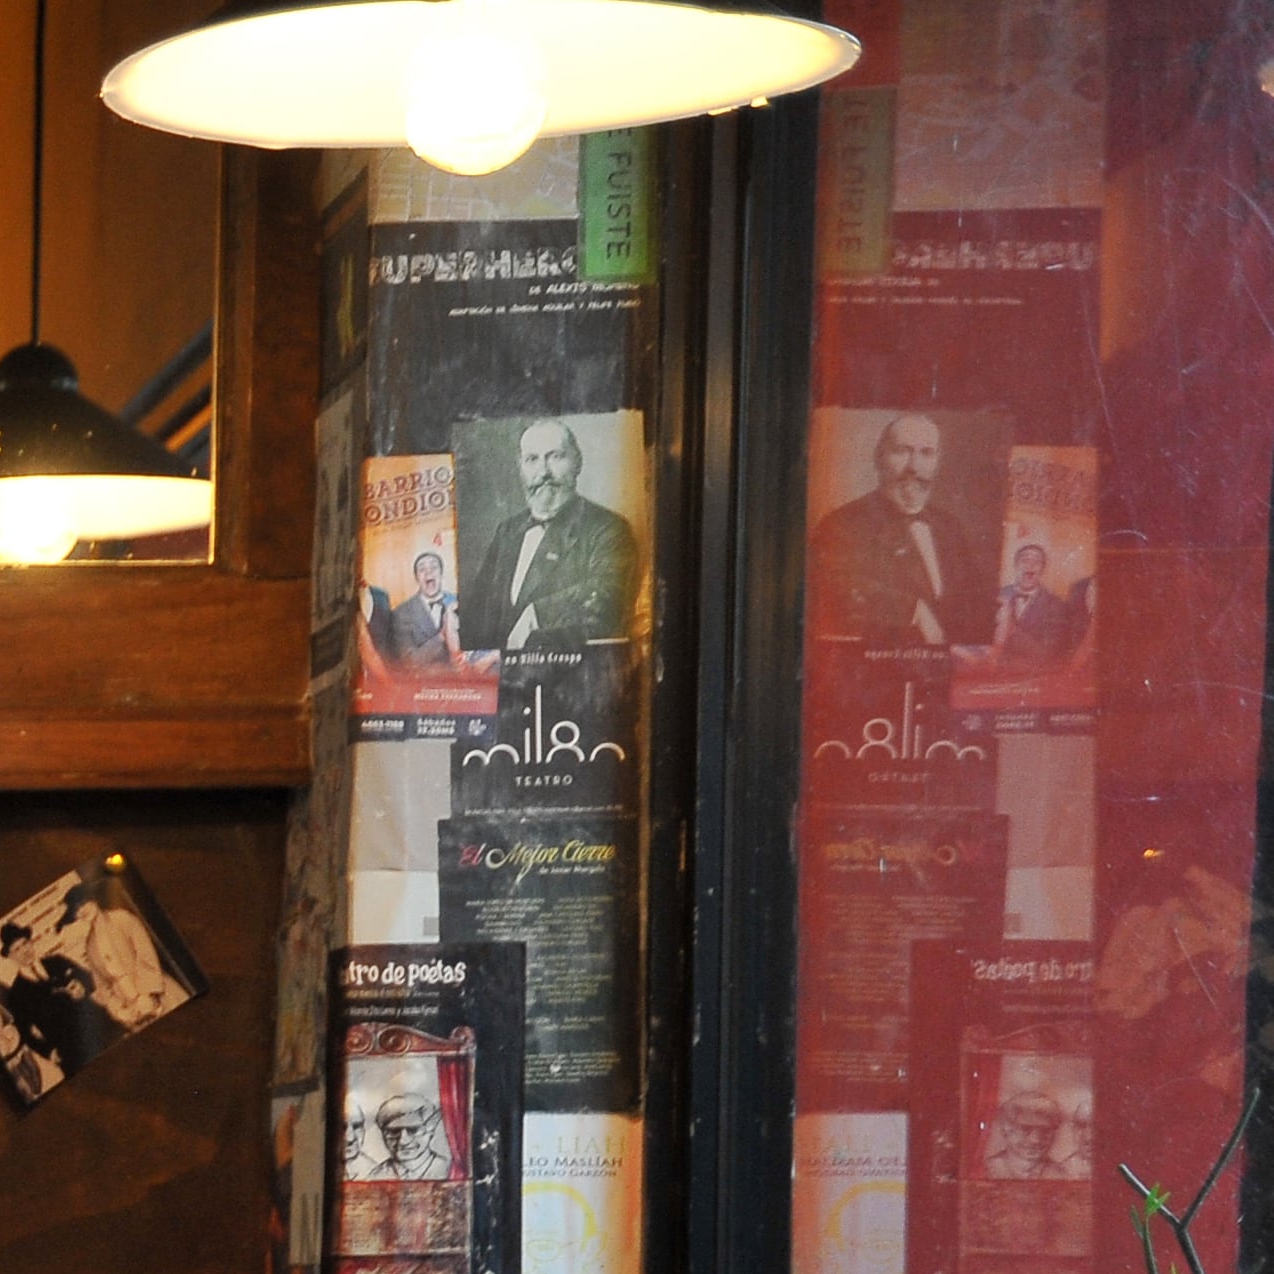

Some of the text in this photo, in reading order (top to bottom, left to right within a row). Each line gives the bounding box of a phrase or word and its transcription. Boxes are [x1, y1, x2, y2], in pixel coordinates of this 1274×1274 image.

[605, 153, 631, 260] FUISTE
[515, 775, 573, 786] TEATRO
[562, 839, 617, 862] Cierre
[382, 961, 406, 985] de
